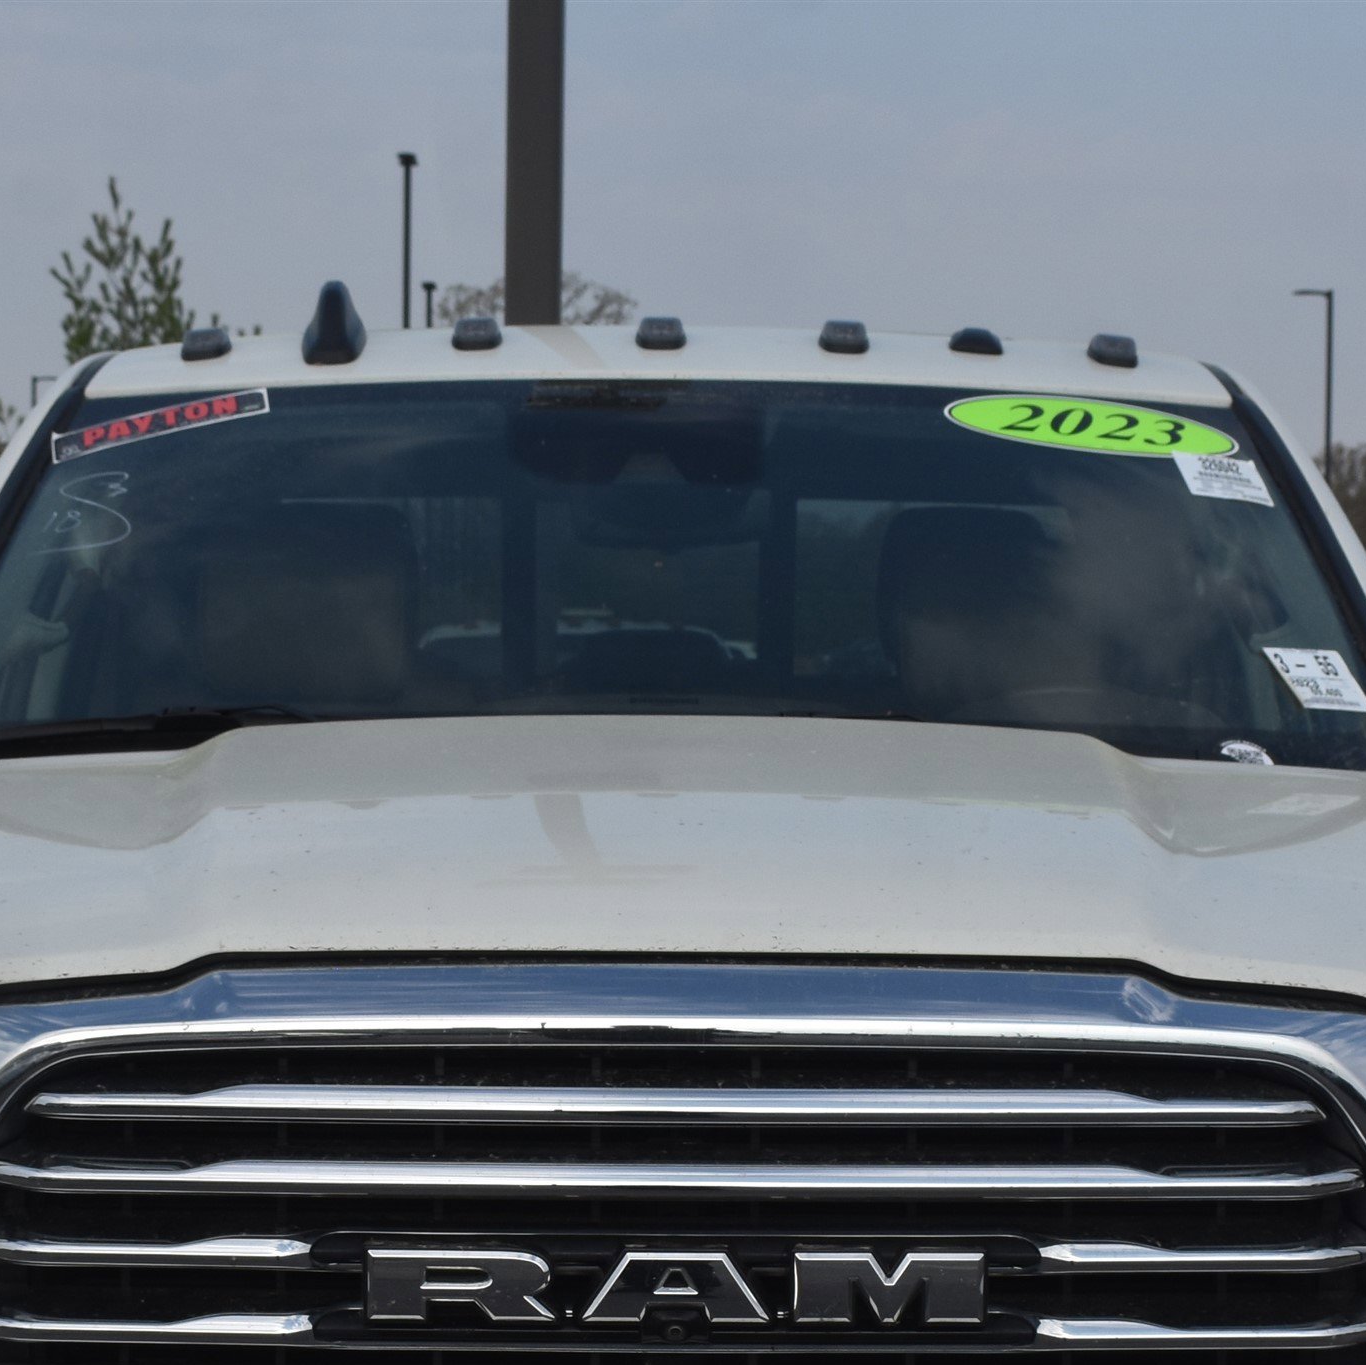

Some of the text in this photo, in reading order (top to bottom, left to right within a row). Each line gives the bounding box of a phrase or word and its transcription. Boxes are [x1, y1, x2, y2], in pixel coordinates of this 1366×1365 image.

[82, 396, 238, 448] PAYTON
[1000, 403, 1187, 447] 2023
[1273, 653, 1290, 674] 3
[1313, 655, 1339, 676] 55
[366, 1248, 987, 1324] RAM
